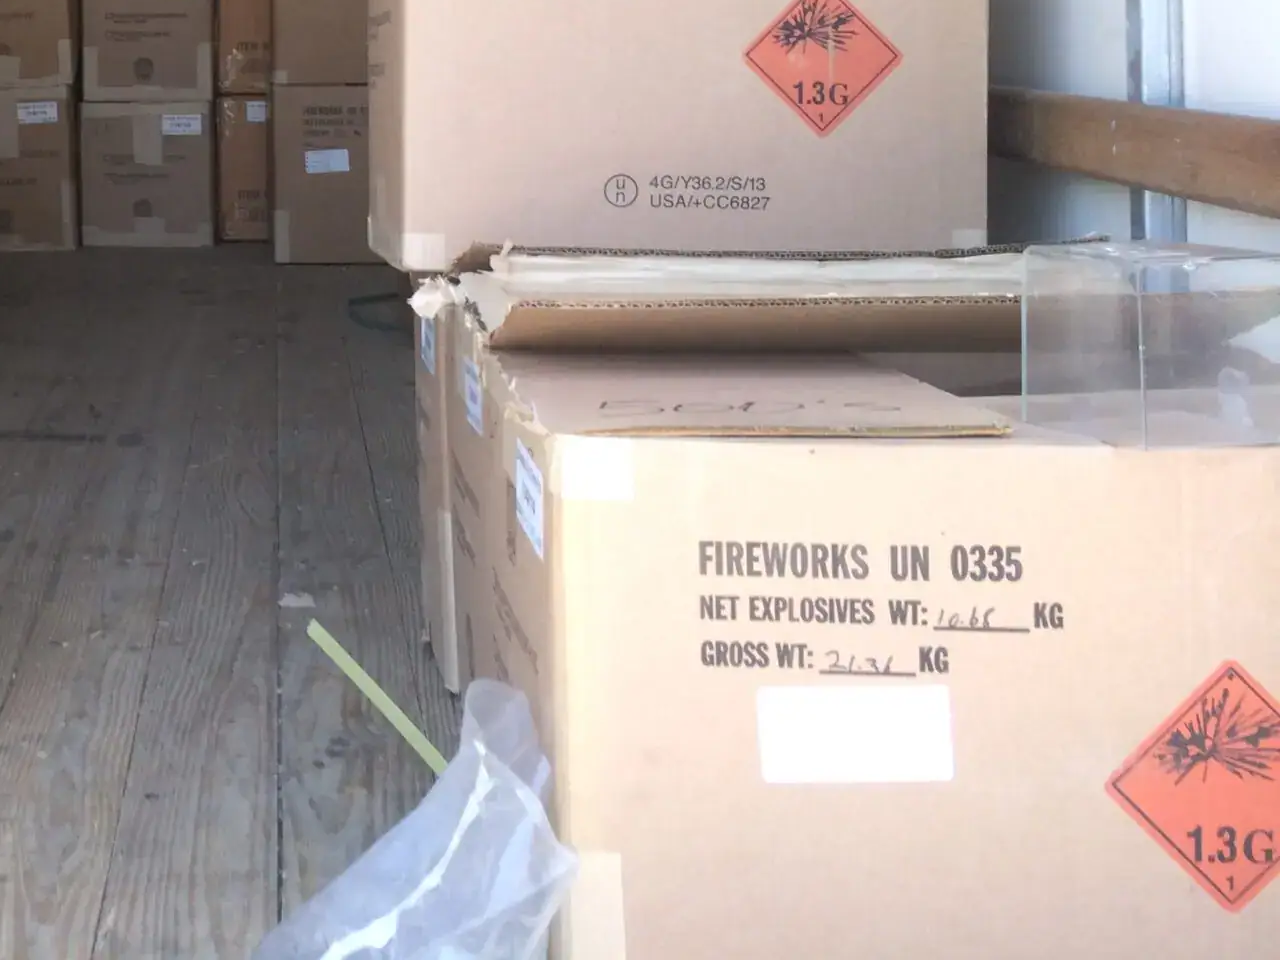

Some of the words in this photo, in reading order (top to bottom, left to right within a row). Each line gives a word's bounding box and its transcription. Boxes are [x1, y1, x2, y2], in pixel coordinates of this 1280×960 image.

[649, 175, 767, 192] 4G/Y36.2/S/13
[649, 194, 771, 211] USA/+CC6827
[698, 540, 870, 581] FIREWORKS
[889, 544, 931, 582] UN
[950, 544, 1024, 583] 0335
[699, 594, 740, 621] NET
[748, 596, 876, 625] EXPLOSIVES
[888, 599, 929, 627] WT:
[1033, 602, 1065, 630] KG
[700, 640, 770, 669] GROSS
[775, 642, 815, 670] WT:
[919, 645, 950, 674] KG
[1225, 874, 1235, 891] 1
